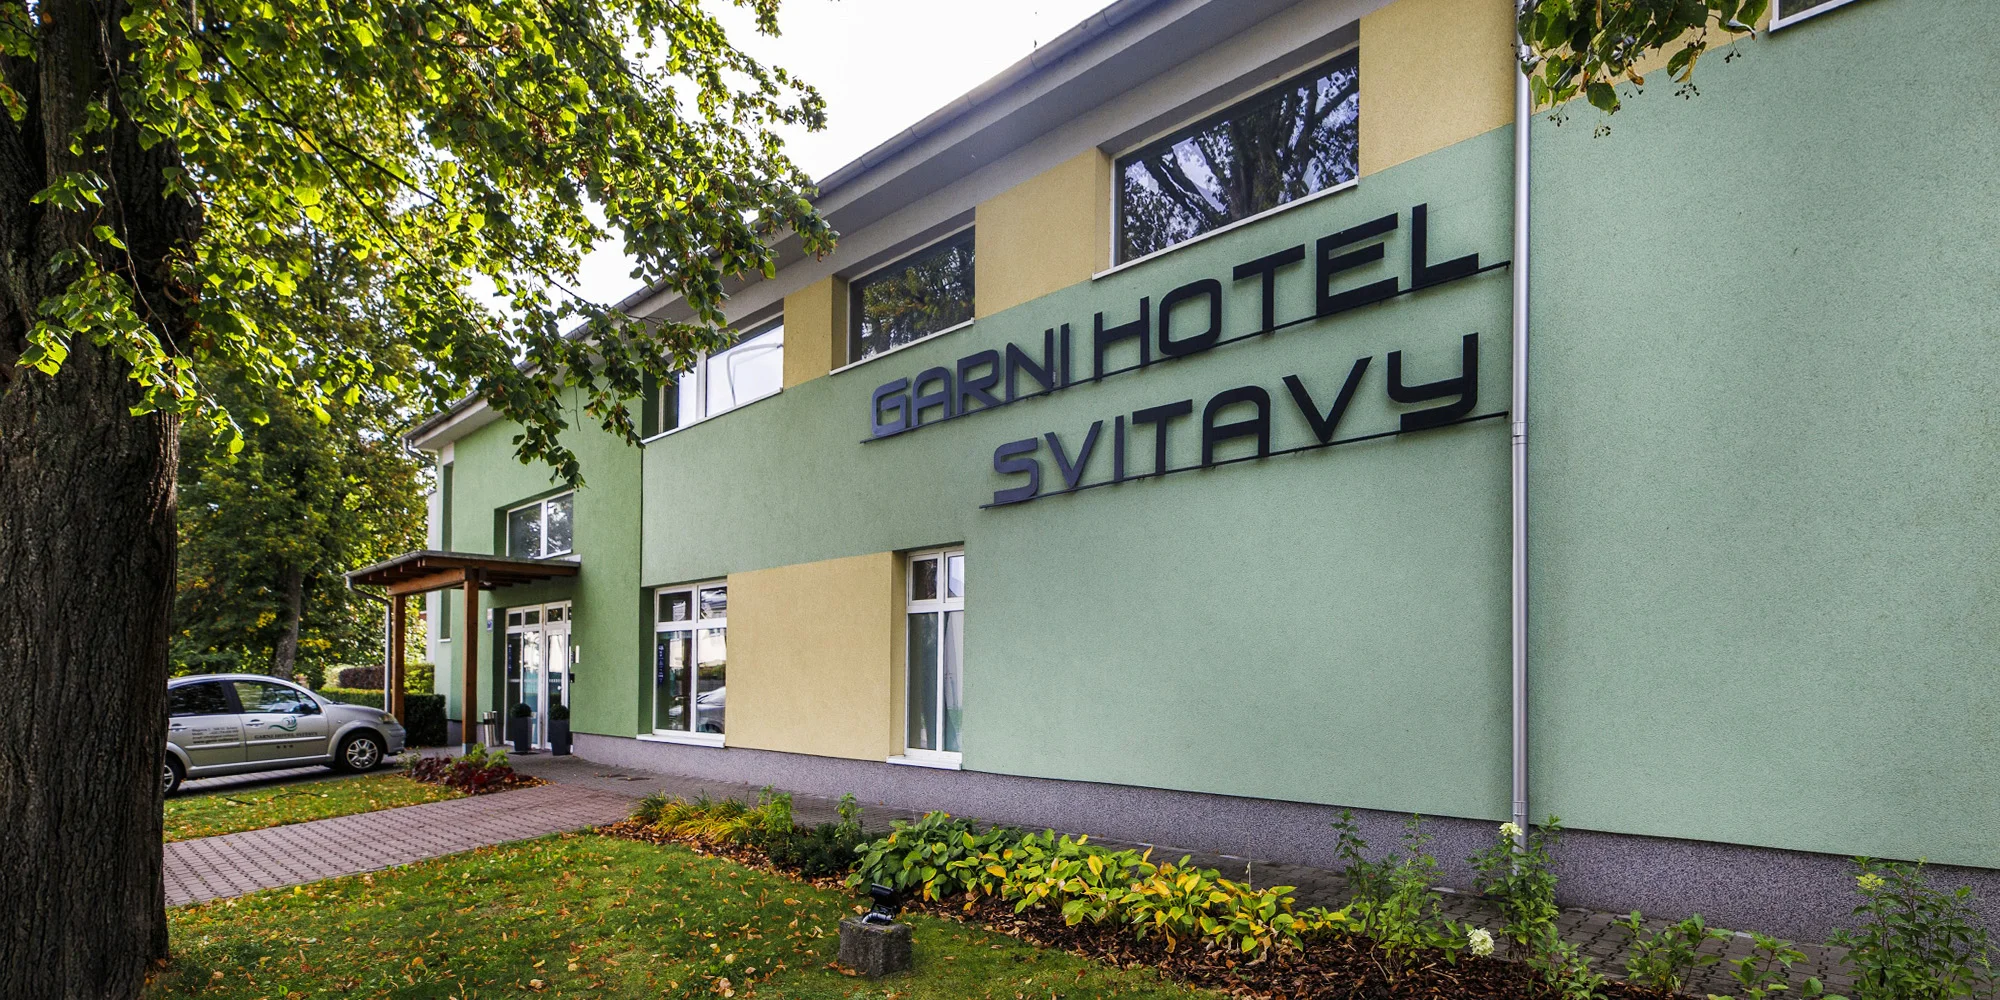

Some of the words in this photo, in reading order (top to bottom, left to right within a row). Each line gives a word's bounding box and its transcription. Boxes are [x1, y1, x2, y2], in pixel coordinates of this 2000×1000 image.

[872, 322, 1070, 437] GARNI
[1094, 203, 1479, 380] HOTEL
[993, 333, 1479, 504] SVITAVY
